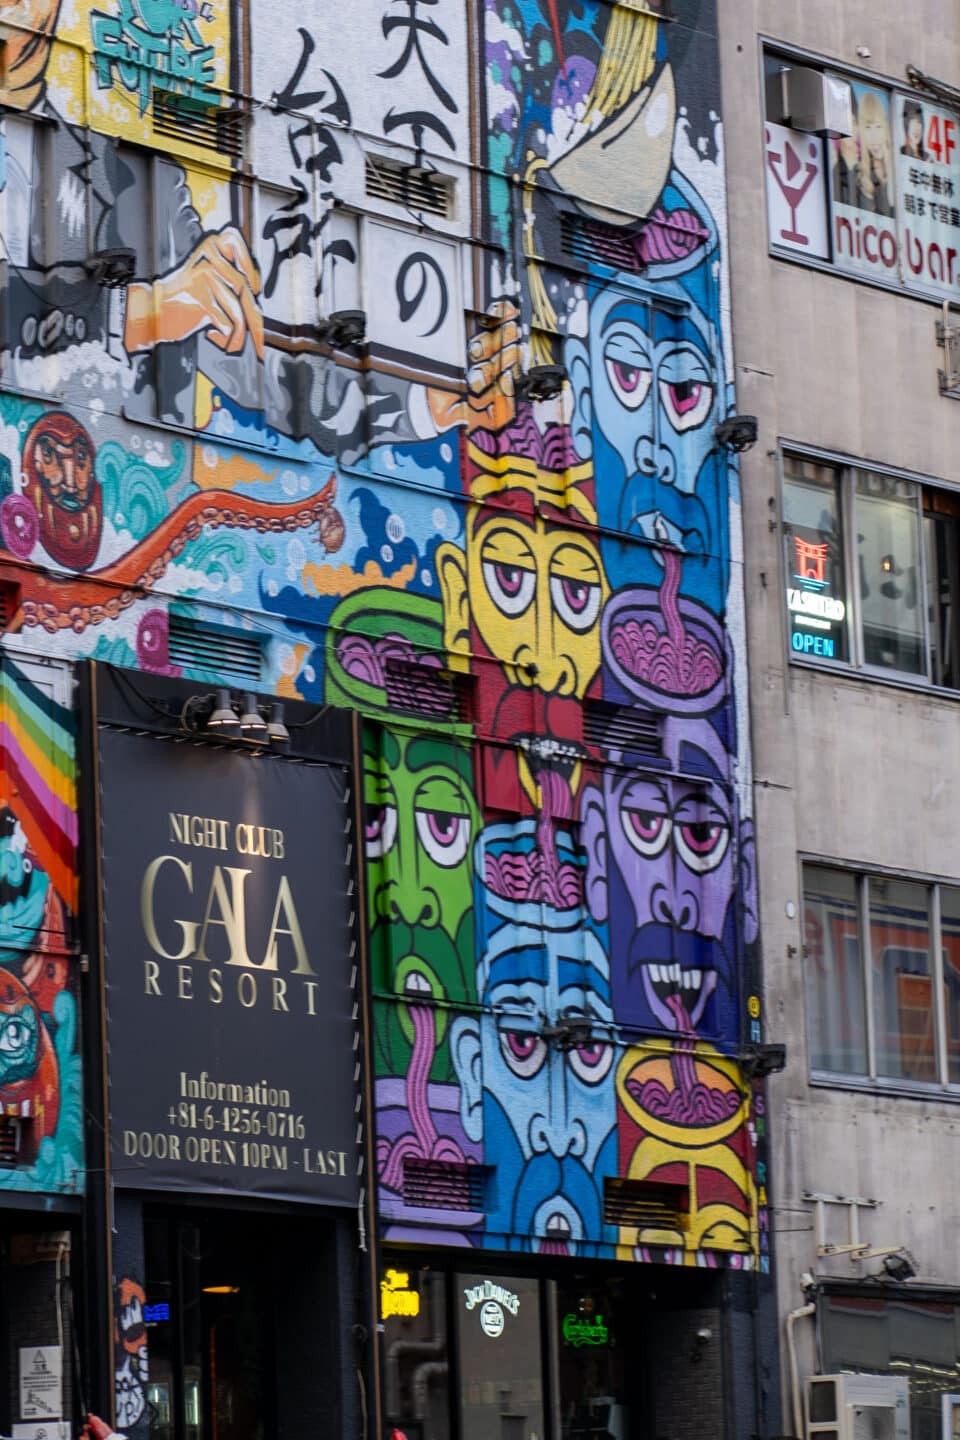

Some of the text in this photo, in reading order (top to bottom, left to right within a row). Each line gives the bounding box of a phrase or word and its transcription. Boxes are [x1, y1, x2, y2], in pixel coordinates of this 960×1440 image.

[927, 115, 957, 165] 4F
[835, 215, 898, 268] nico
[792, 632, 835, 657] OPEN
[167, 812, 286, 860] NIGHT CLUB
[140, 854, 319, 977] GALA
[143, 960, 320, 1016] RESORT
[179, 1071, 291, 1108] Information
[123, 1130, 181, 1160] DOOR
[185, 1137, 238, 1166] OPEN
[242, 1142, 289, 1171] 10PM
[303, 1148, 348, 1177] LAST
